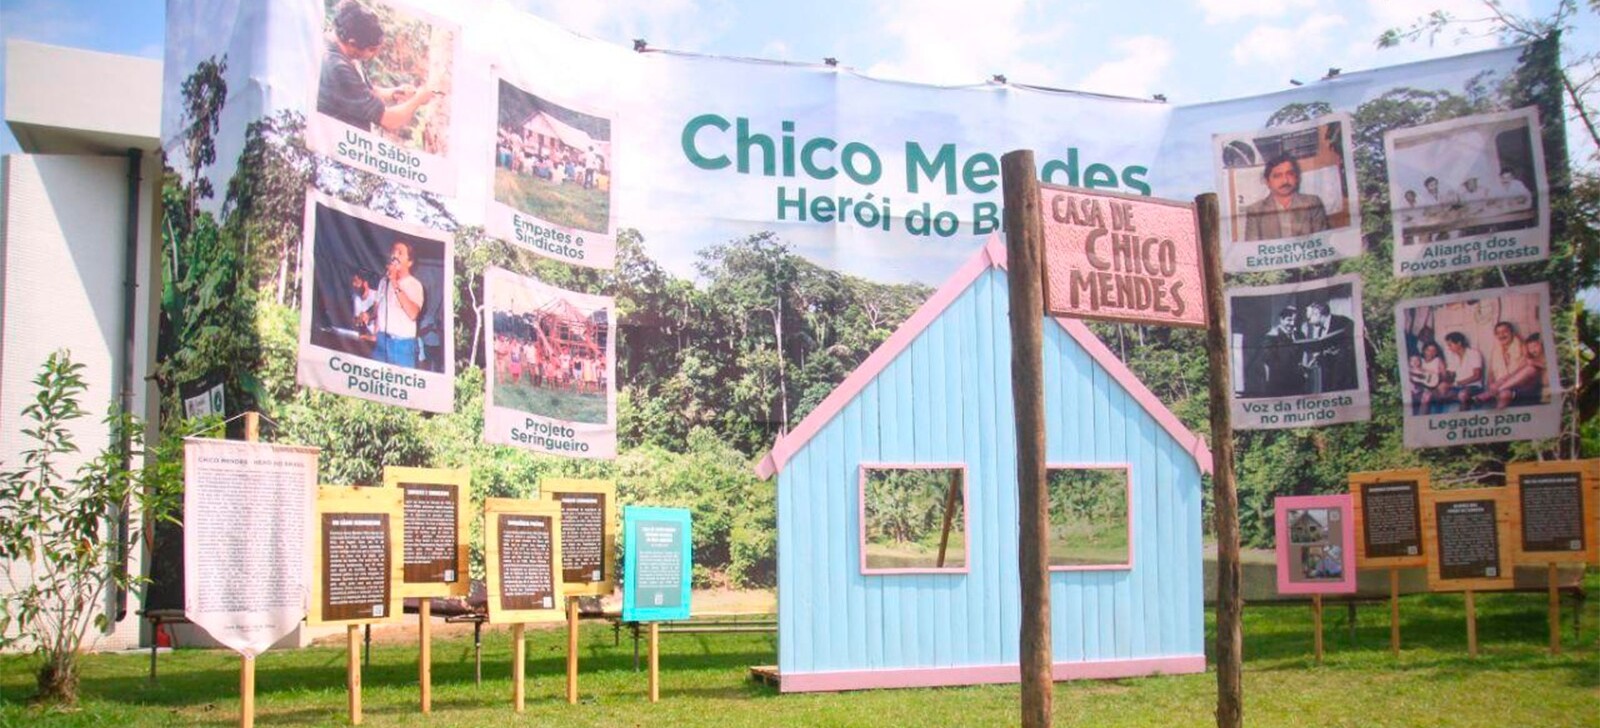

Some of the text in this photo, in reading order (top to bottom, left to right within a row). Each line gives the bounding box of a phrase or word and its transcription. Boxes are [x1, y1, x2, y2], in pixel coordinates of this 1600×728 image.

[338, 141, 427, 183] Seringueiro
[346, 130, 420, 168] Um Sábio
[681, 113, 1152, 196] Chico Medes
[777, 186, 890, 231] Herói
[905, 200, 959, 237] do
[1051, 194, 1136, 232] CASA DE
[513, 214, 584, 246] Empates e
[515, 228, 584, 260] Sindicatos
[1085, 228, 1176, 277] CHICO
[1246, 246, 1335, 267] Extrativistas
[1257, 238, 1322, 255] Reservas
[1422, 236, 1517, 259] Aliança dos
[1400, 245, 1540, 272] Povos da floresta
[1069, 269, 1185, 317] MENDES
[329, 357, 426, 389] Consciência
[348, 376, 408, 400] Política
[1242, 396, 1353, 413] Voz da floresta
[1260, 409, 1335, 423] no mundo
[525, 417, 575, 438] Projeto
[1429, 412, 1532, 430] Legado para
[1446, 426, 1512, 441] o futuro
[511, 428, 589, 452] Seringueiro
